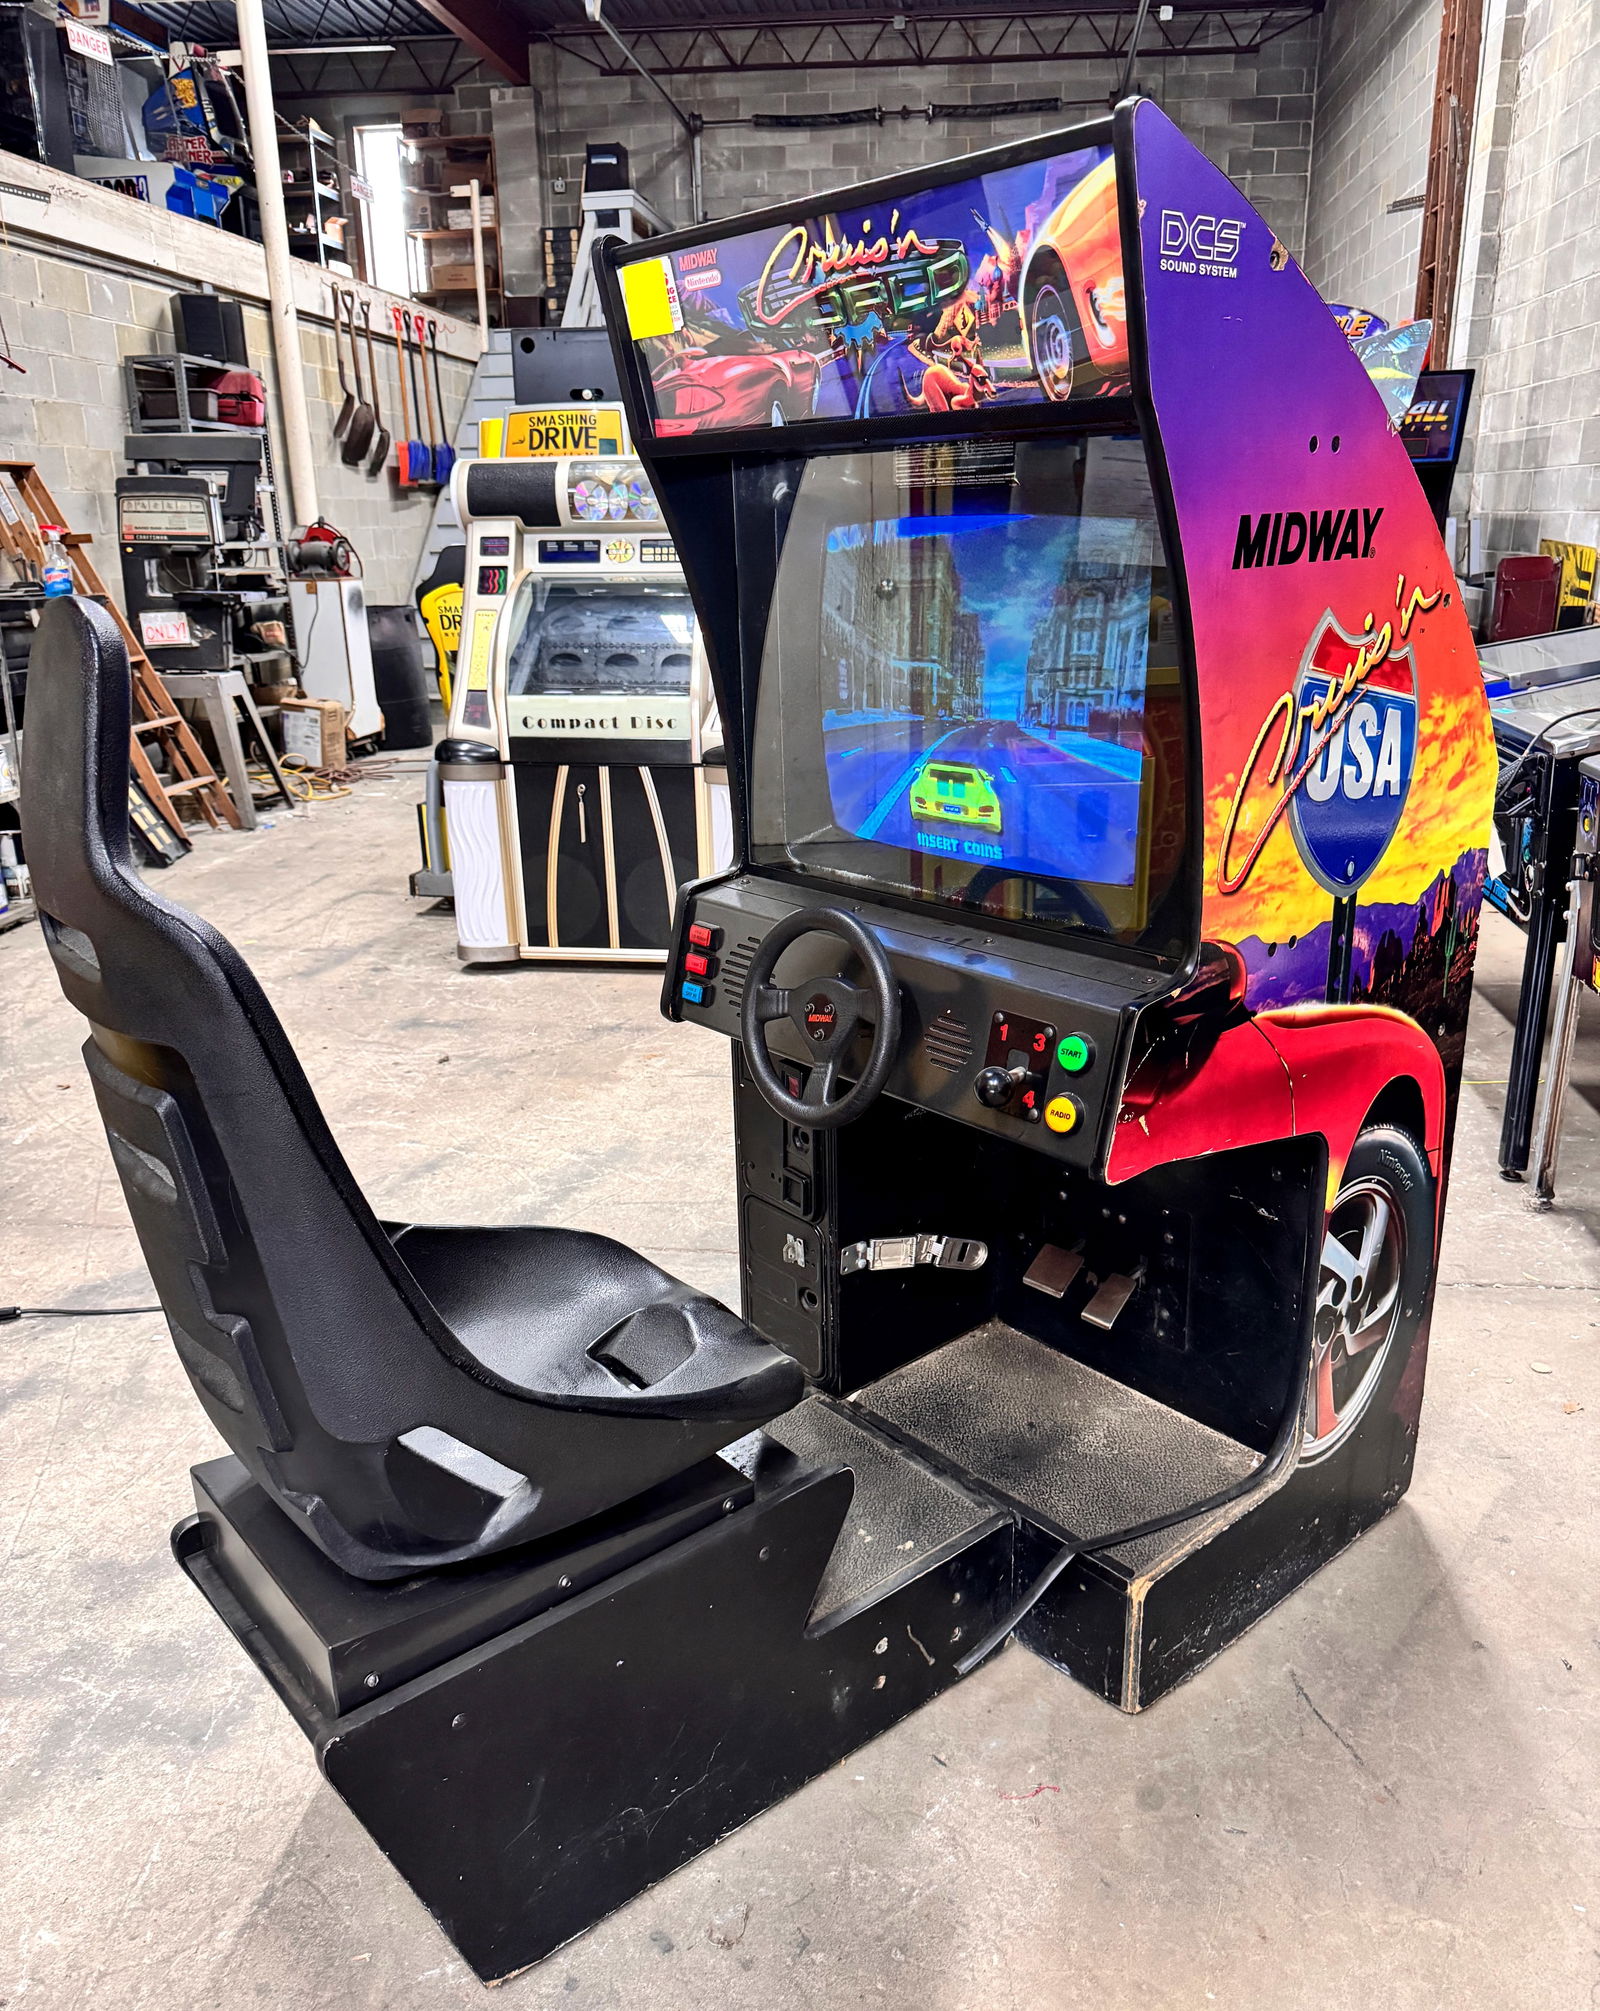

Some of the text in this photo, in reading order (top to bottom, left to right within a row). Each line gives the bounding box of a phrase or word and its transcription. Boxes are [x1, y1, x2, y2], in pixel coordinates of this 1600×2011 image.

[68, 29, 109, 57] DANGER
[1160, 209, 1240, 262] DCS
[678, 248, 718, 272] MIDWAY
[1160, 259, 1237, 278] SOUND SYSTEM
[686, 273, 720, 288] Nintendo
[528, 414, 597, 427] SMASHING
[528, 426, 597, 450] DRIVE
[1232, 508, 1384, 569] MIDWAY
[522, 715, 677, 730] Compact Disc
[1217, 574, 1440, 893] Cruis'n
[1304, 698, 1401, 802] USA
[917, 832, 1003, 860] INSERT COINS
[808, 1013, 833, 1022] MIDWAY
[1000, 1024, 1009, 1041] 1
[1033, 1033, 1046, 1051] 3
[1060, 1048, 1083, 1059] START
[1022, 1090, 1035, 1108] 4
[1050, 1109, 1071, 1120] RADIO
